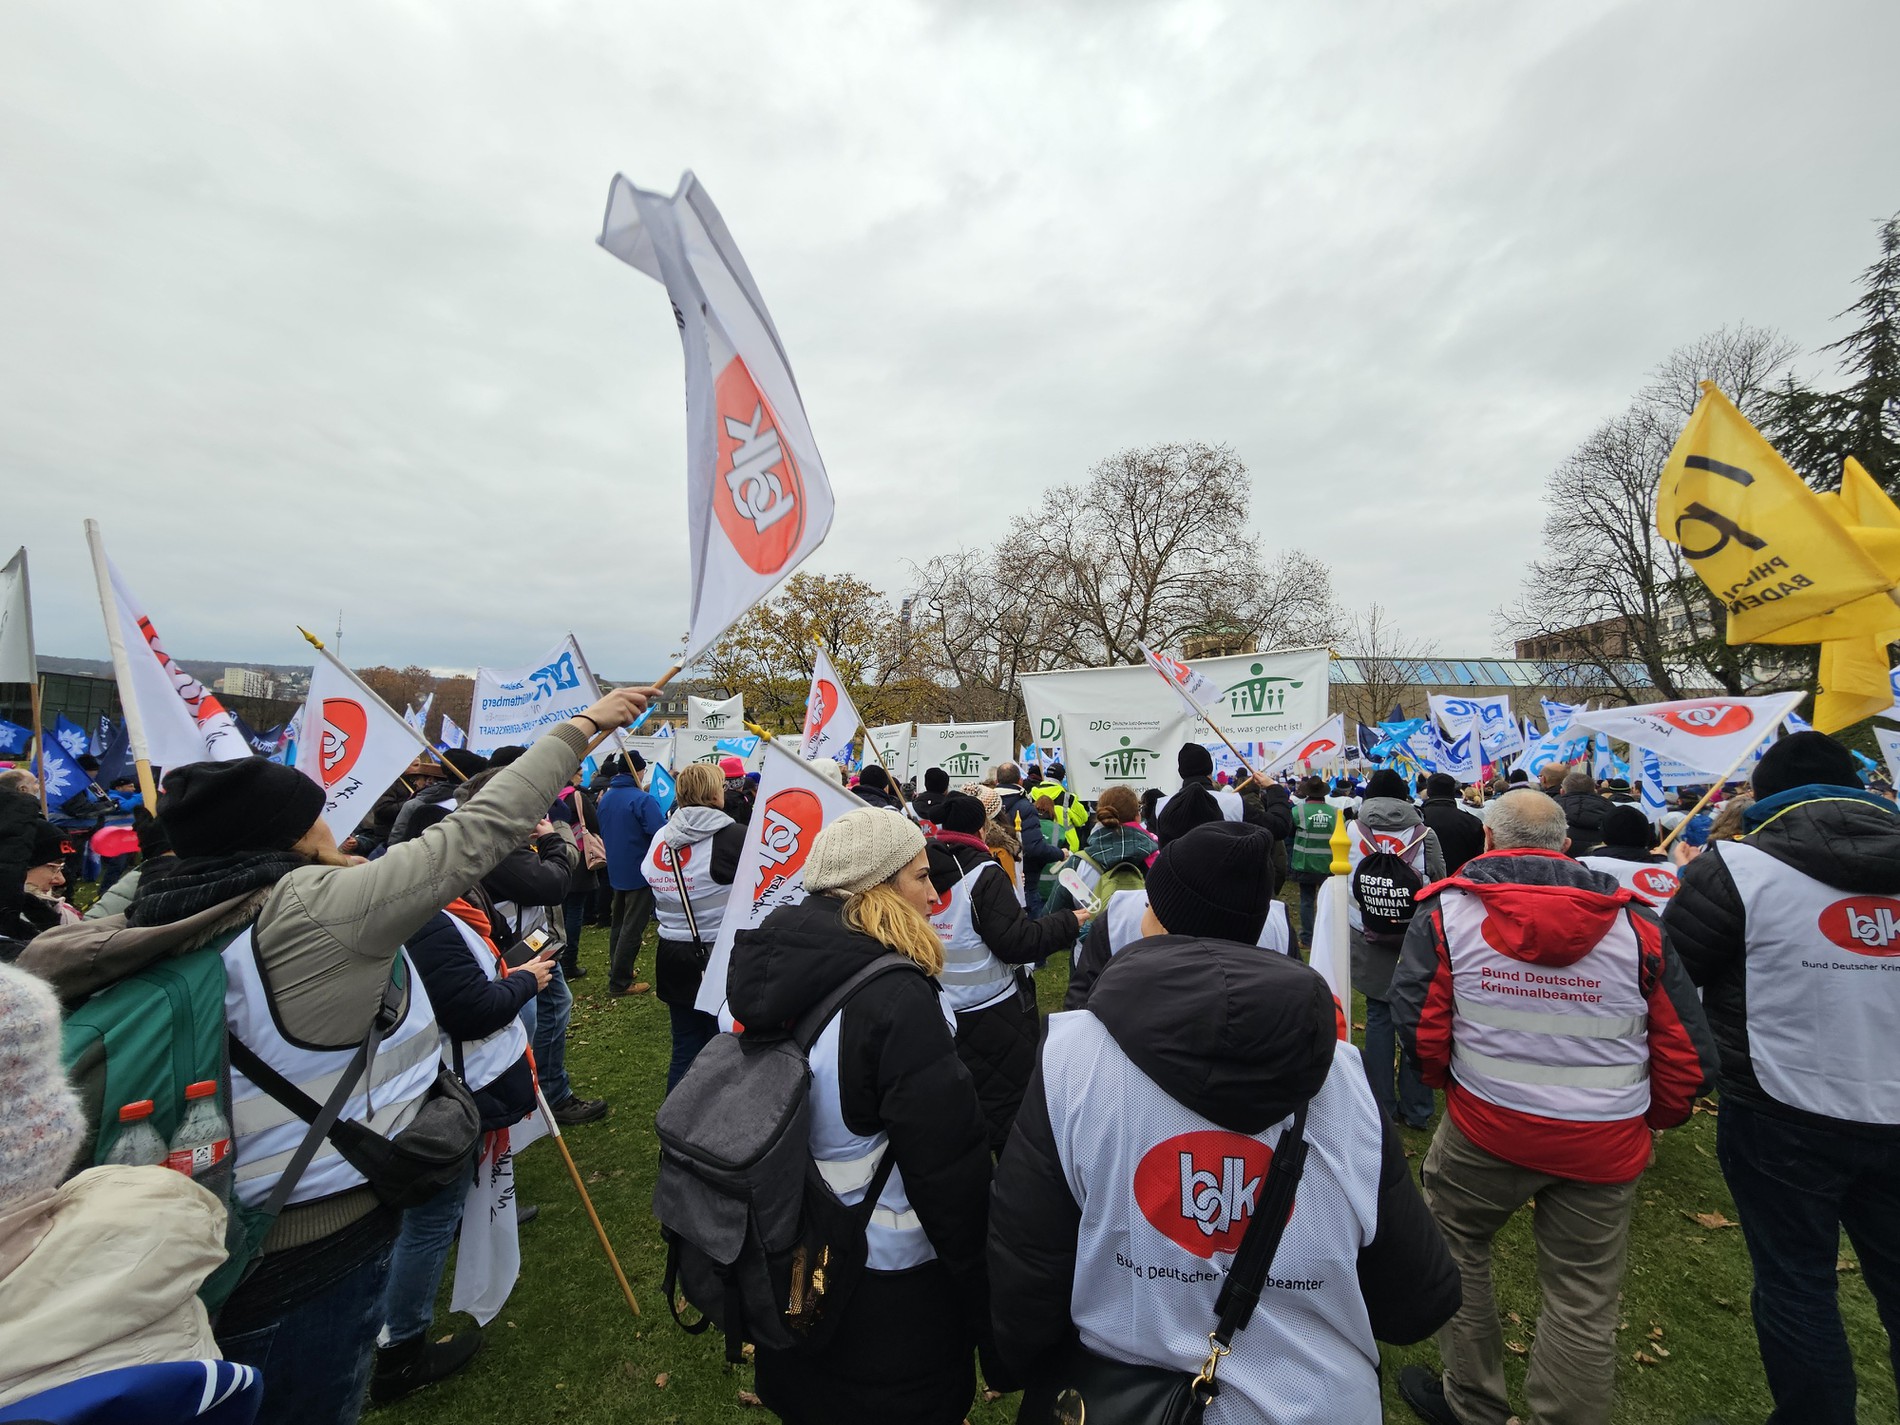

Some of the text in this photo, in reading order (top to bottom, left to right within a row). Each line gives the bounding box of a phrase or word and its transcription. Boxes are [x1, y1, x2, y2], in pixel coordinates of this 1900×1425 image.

[1040, 714, 1062, 742] DJ
[1089, 720, 1111, 732] DJG
[1255, 724, 1287, 734] gerecht
[1289, 722, 1303, 730] ist!
[940, 729, 955, 739] DJG
[1359, 874, 1394, 888] BESTER
[1644, 872, 1678, 893] bdk
[1360, 884, 1411, 898] STOFF DER
[1363, 895, 1410, 907] KRIMINAL
[1366, 905, 1401, 917] POLIZEI
[1801, 960, 1829, 970] Bund
[1832, 962, 1879, 972] Deutscher
[1481, 966, 1602, 989] Bund Deutscher
[1481, 980, 1603, 1004] Kriminalbeamter
[1178, 1151, 1262, 1237] bdk
[1116, 1252, 1143, 1279] Bund
[1148, 1265, 1220, 1284] Deutscher
